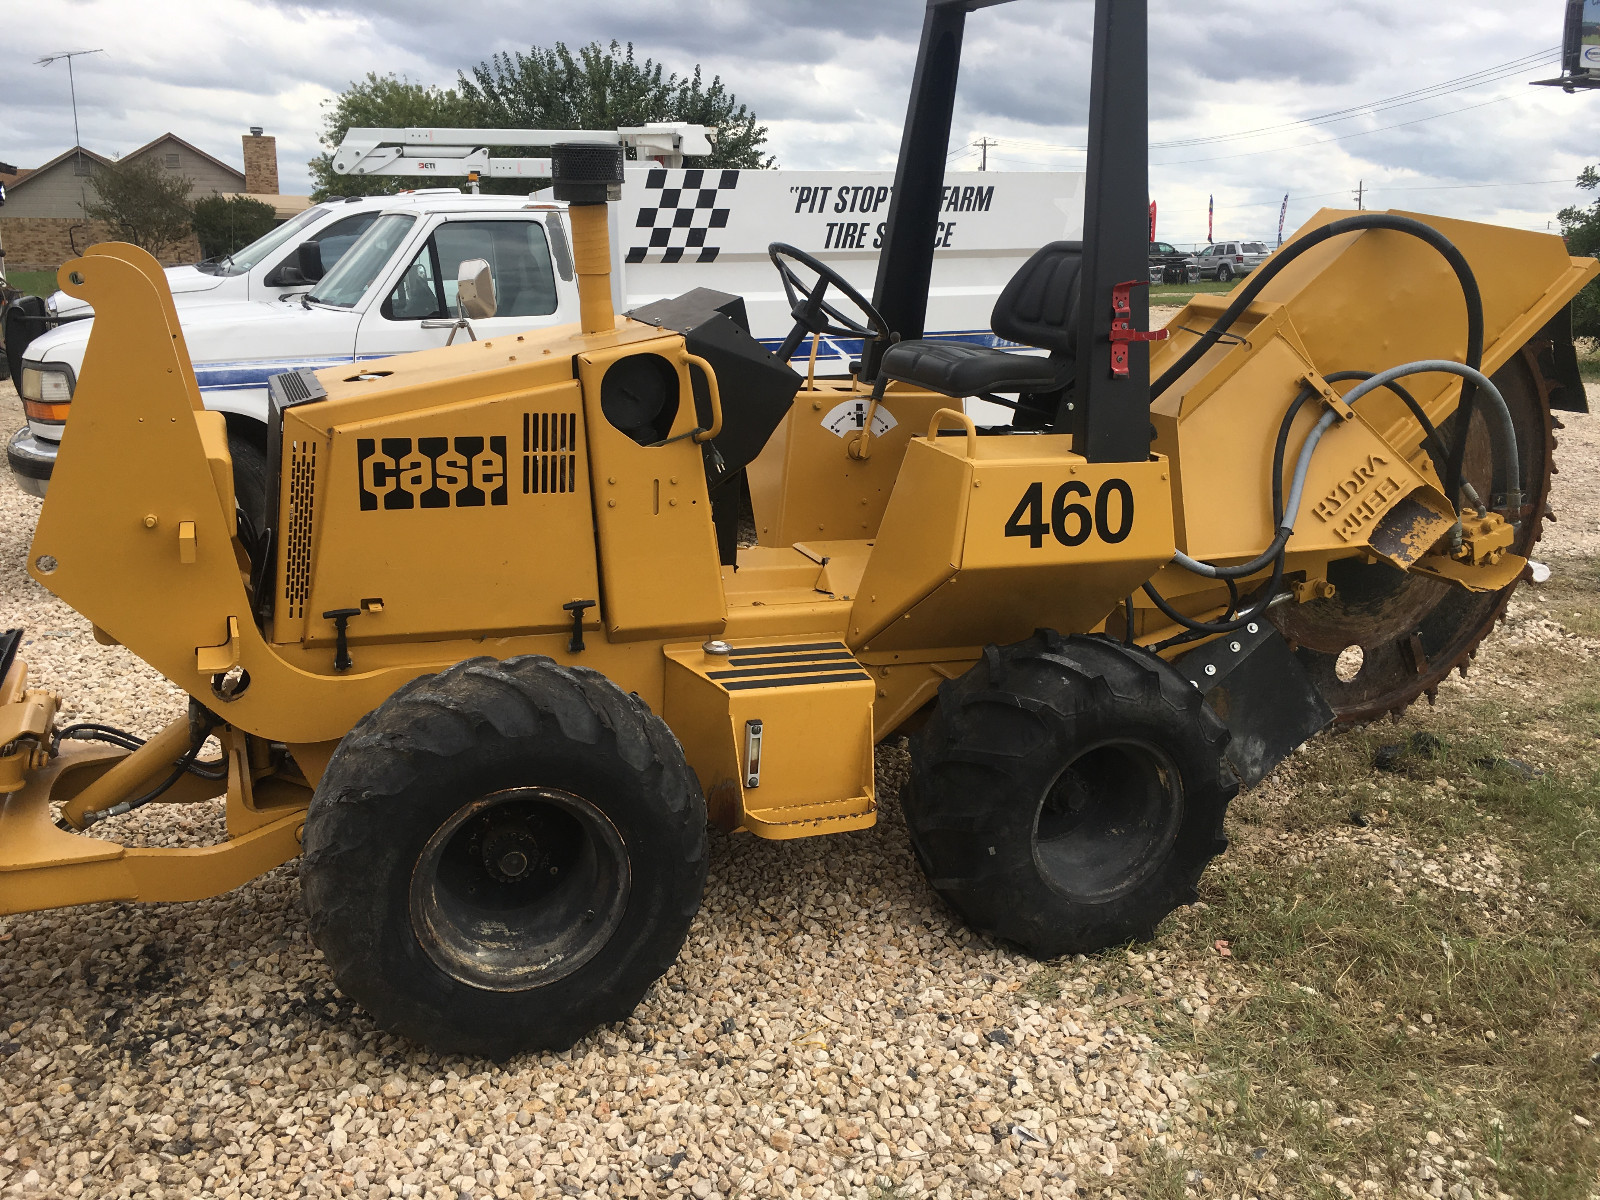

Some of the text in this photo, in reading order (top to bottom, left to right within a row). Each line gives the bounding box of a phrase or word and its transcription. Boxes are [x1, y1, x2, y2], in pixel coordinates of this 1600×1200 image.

[939, 186, 995, 212] FARM
[824, 222, 870, 249] TIRE
[1004, 478, 1134, 548] 460
[1312, 453, 1389, 523] HYDRA
[1333, 477, 1410, 543] WHEEL
